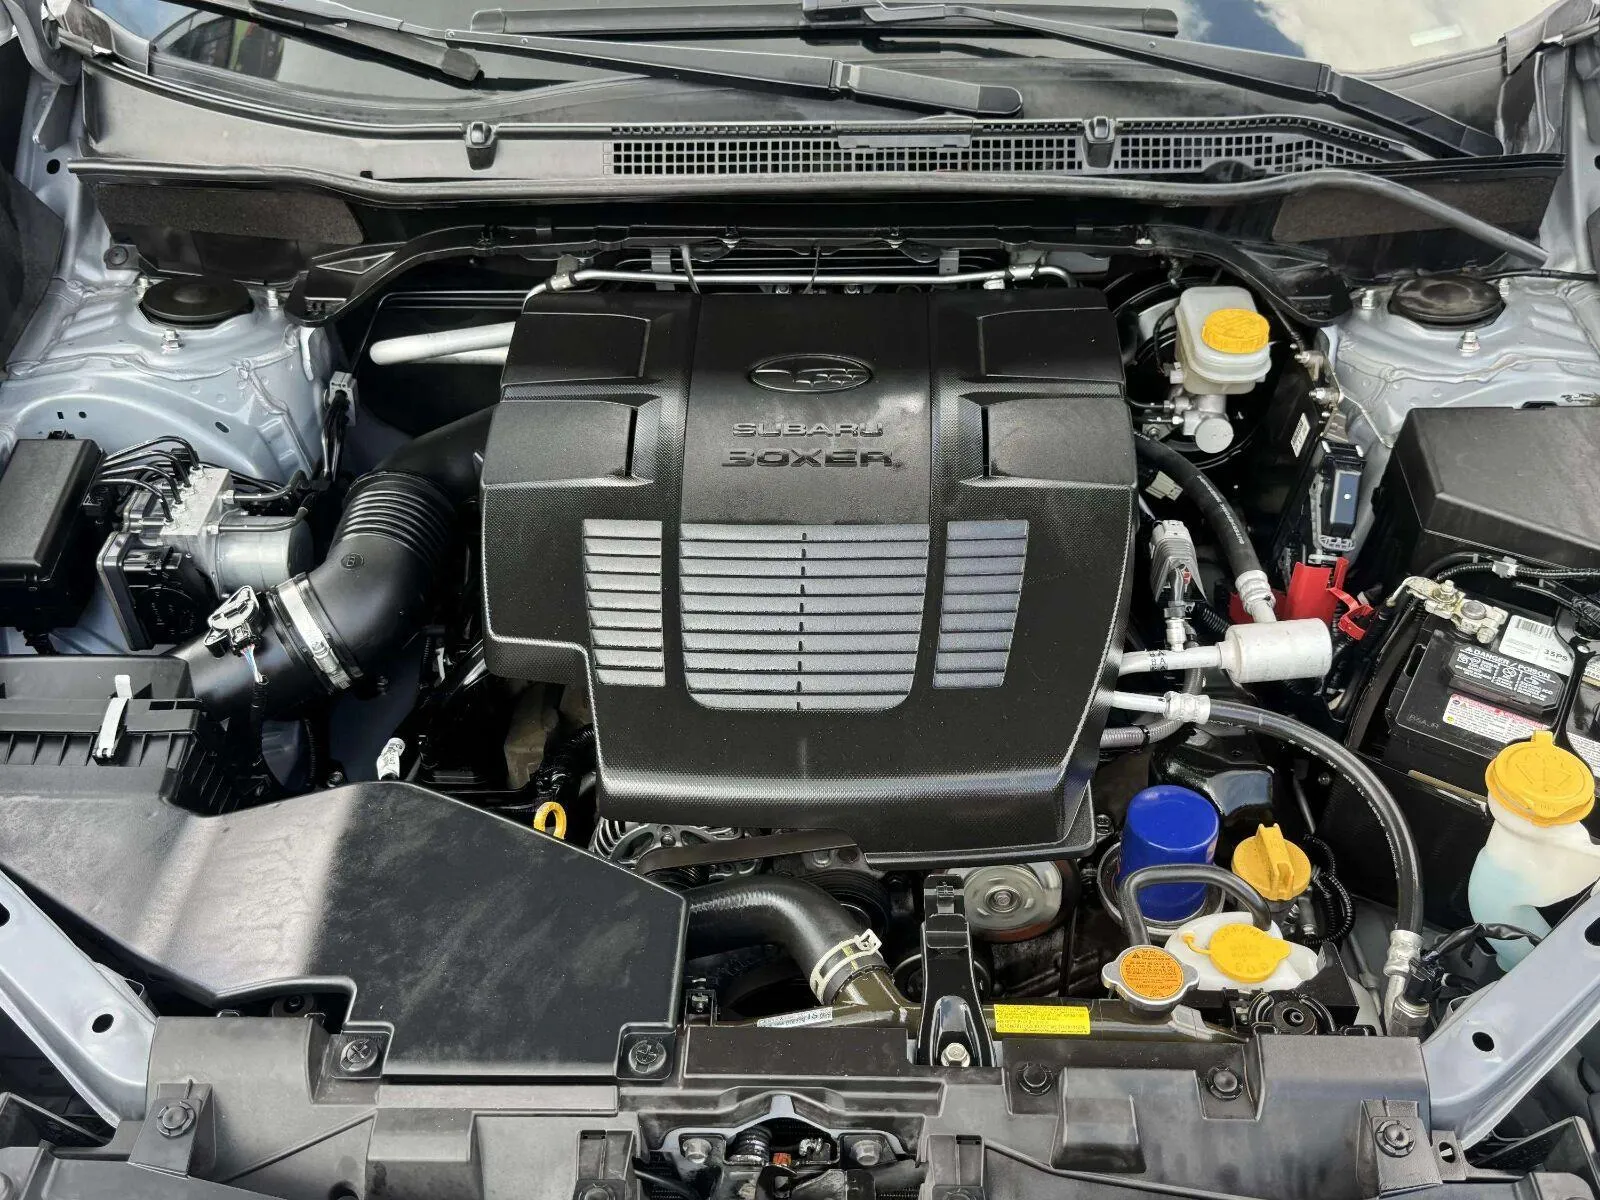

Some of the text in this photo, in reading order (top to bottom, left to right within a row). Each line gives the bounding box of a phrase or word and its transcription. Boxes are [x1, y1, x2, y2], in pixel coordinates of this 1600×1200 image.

[732, 423, 884, 438] SUBARU
[722, 449, 893, 468] BOXER
[1475, 649, 1510, 665] DANGER
[1518, 664, 1551, 679] POISON
